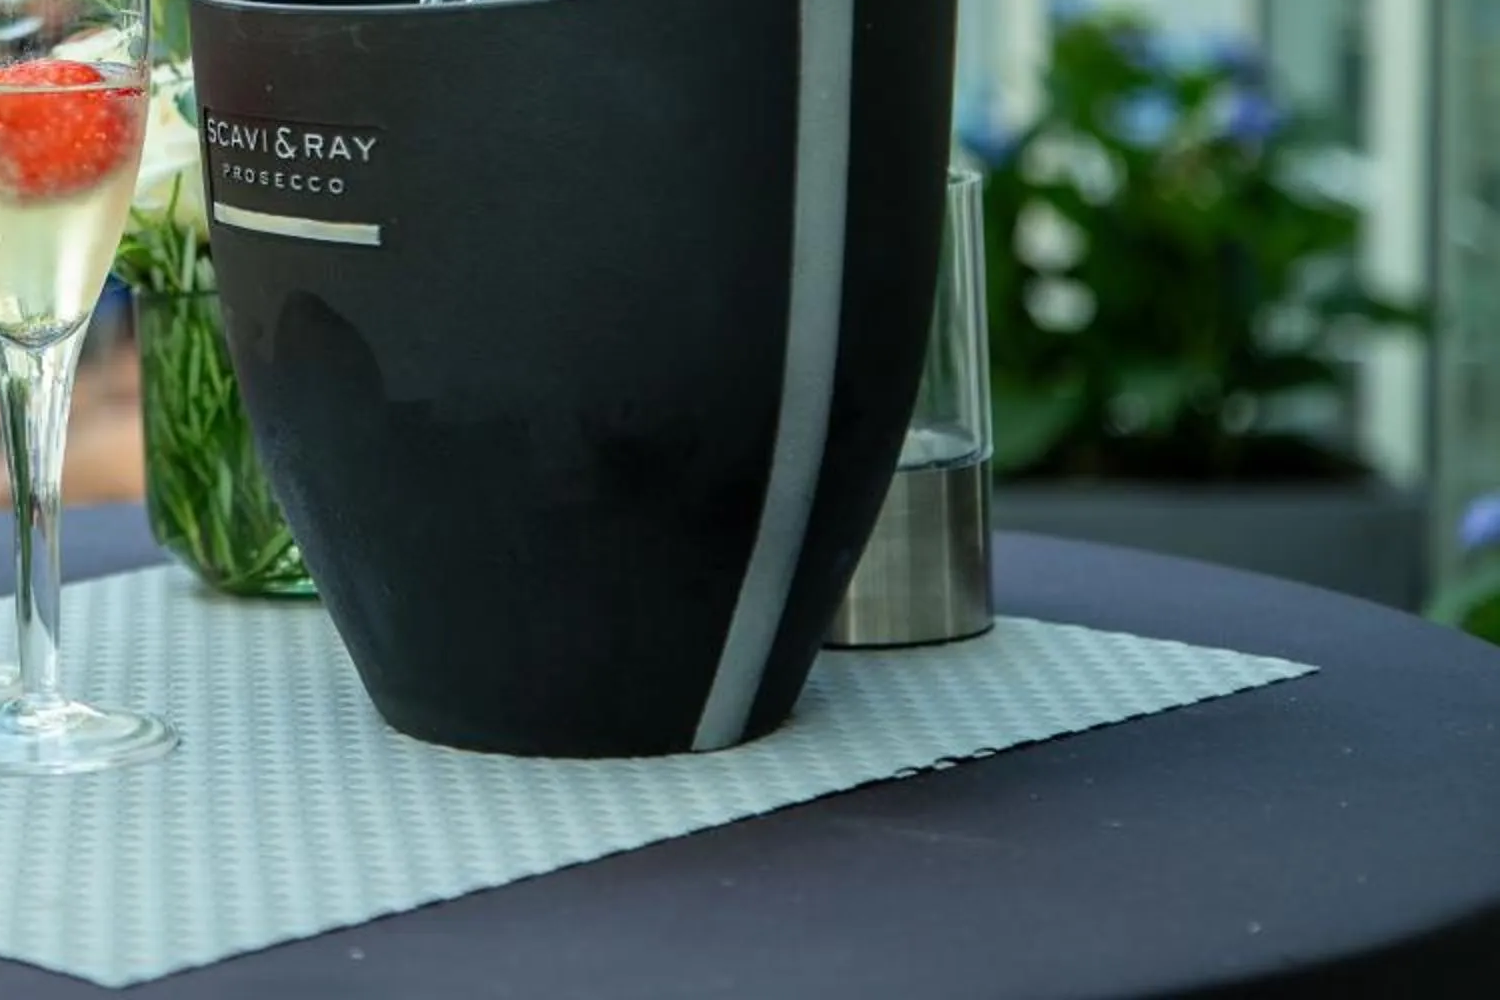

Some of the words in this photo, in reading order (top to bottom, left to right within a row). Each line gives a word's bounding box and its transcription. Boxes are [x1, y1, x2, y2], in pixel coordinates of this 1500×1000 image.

[207, 117, 268, 153] SCAVI
[274, 126, 299, 160] &
[303, 132, 377, 162] RAY
[222, 162, 345, 195] PROSECCO
